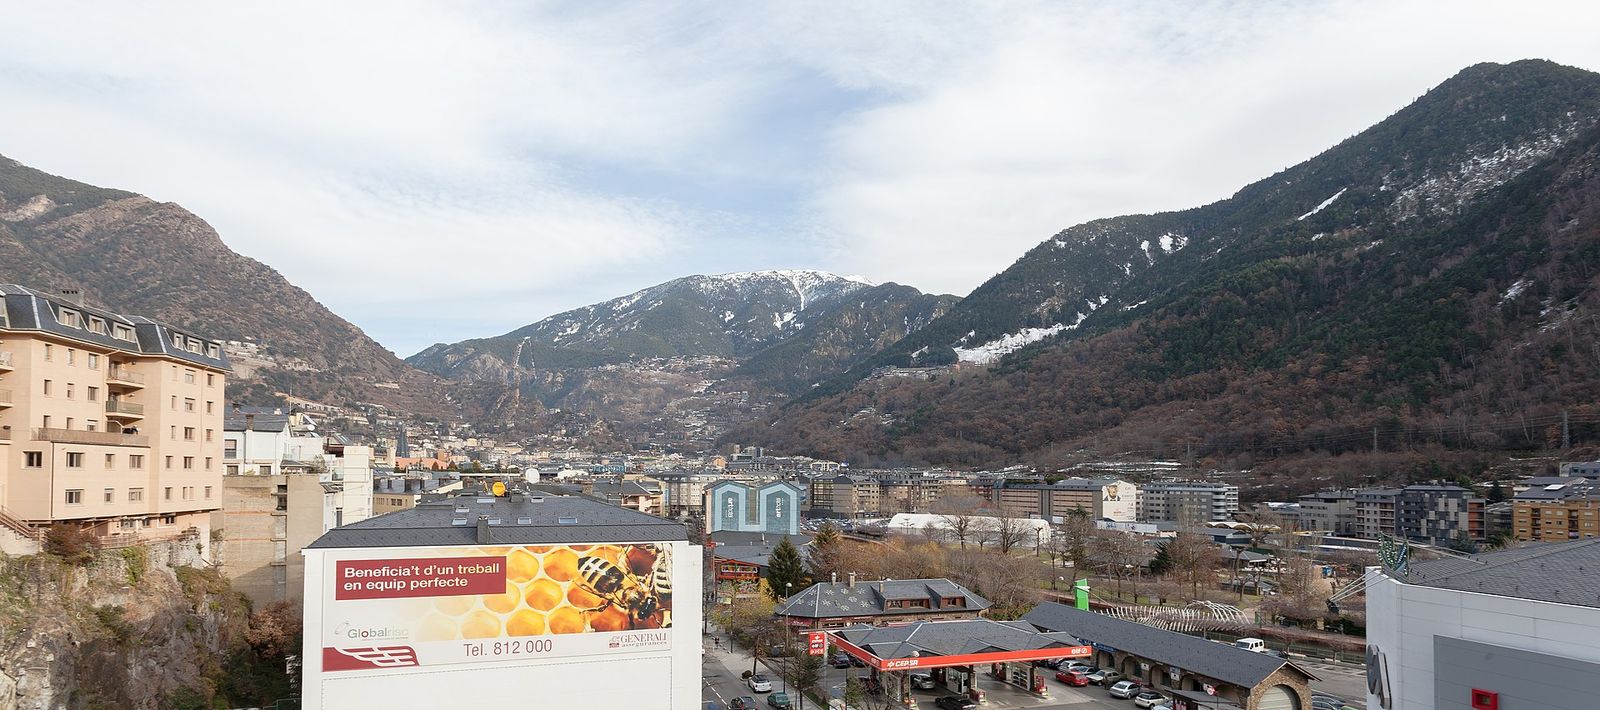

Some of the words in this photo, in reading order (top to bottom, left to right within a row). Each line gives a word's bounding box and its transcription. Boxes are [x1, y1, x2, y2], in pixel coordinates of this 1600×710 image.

[344, 566, 420, 578] Beneficia't
[423, 565, 454, 576] d'un
[457, 563, 500, 575] treball
[343, 581, 362, 591] en
[365, 579, 406, 592] equip
[410, 577, 468, 590] perfecte
[620, 632, 667, 643] GENERALI
[463, 643, 488, 657] Tel.
[493, 641, 520, 655] 812
[525, 639, 552, 653] 000
[895, 659, 919, 667] CEPSA
